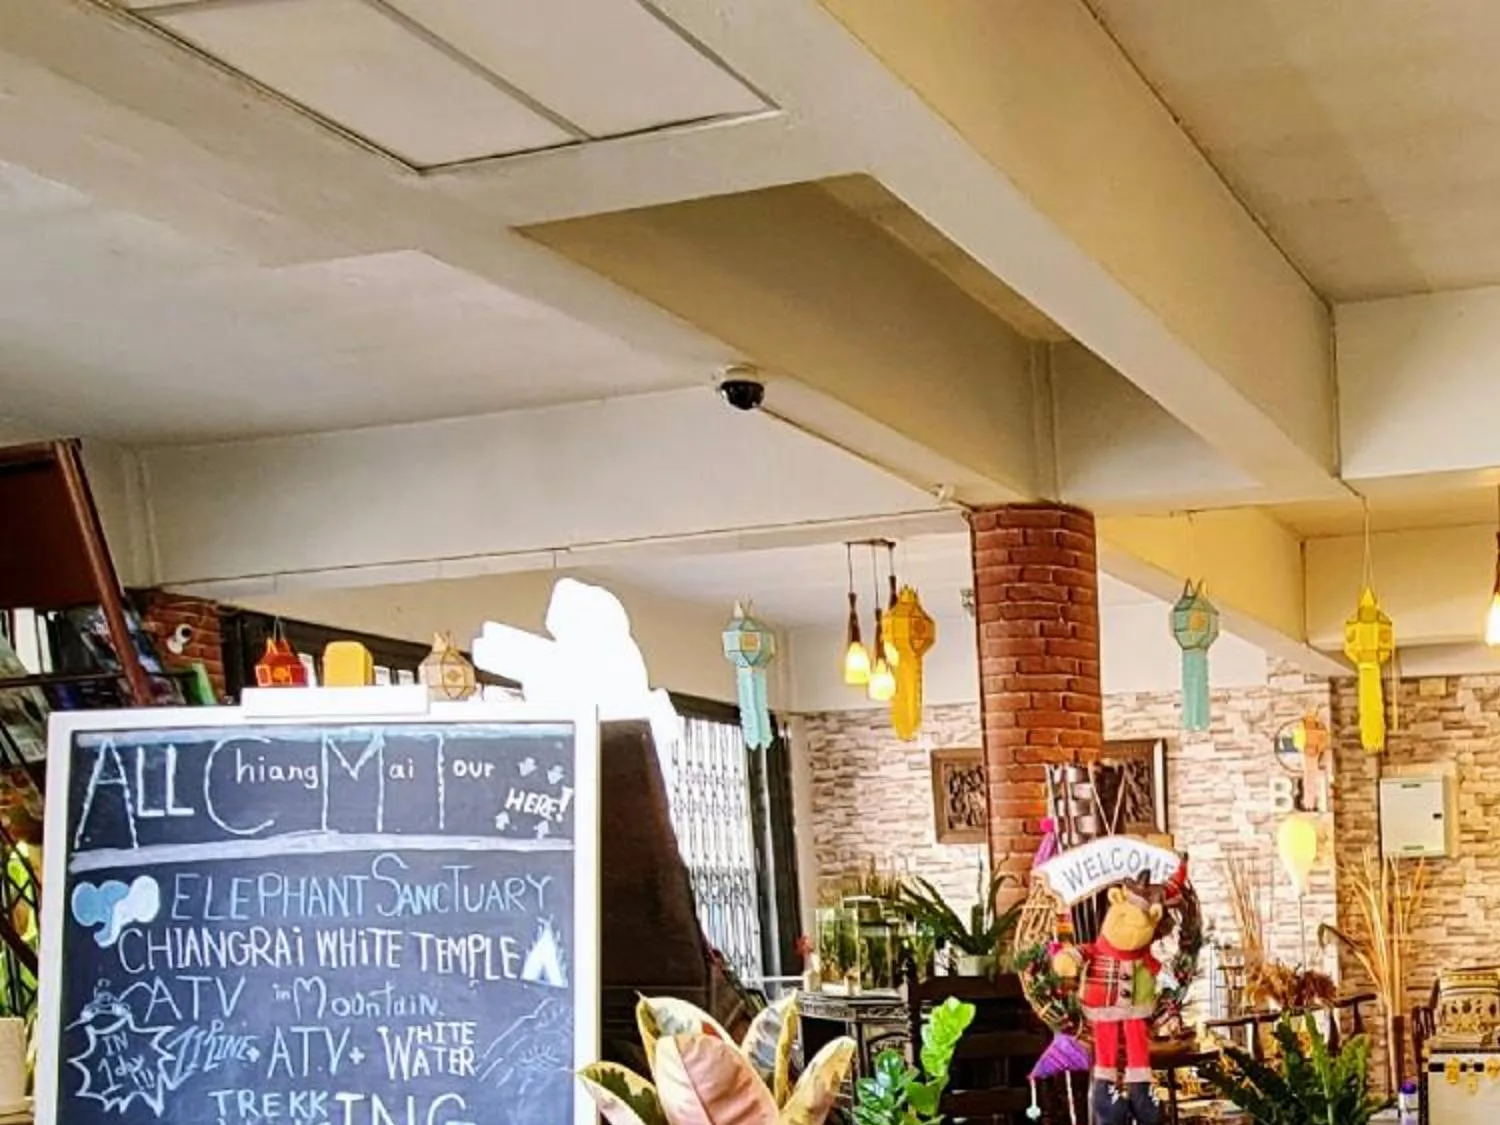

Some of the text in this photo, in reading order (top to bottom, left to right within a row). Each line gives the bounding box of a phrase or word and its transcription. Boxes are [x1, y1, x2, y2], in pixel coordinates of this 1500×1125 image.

[76, 740, 195, 849] ALL
[204, 735, 322, 835] Chiang
[323, 731, 414, 833] Mai
[171, 853, 553, 920] ELEPHANT SANCTUARY
[411, 931, 521, 981] TEMPLE
[144, 976, 246, 1022] ATV
[272, 983, 291, 1000] in
